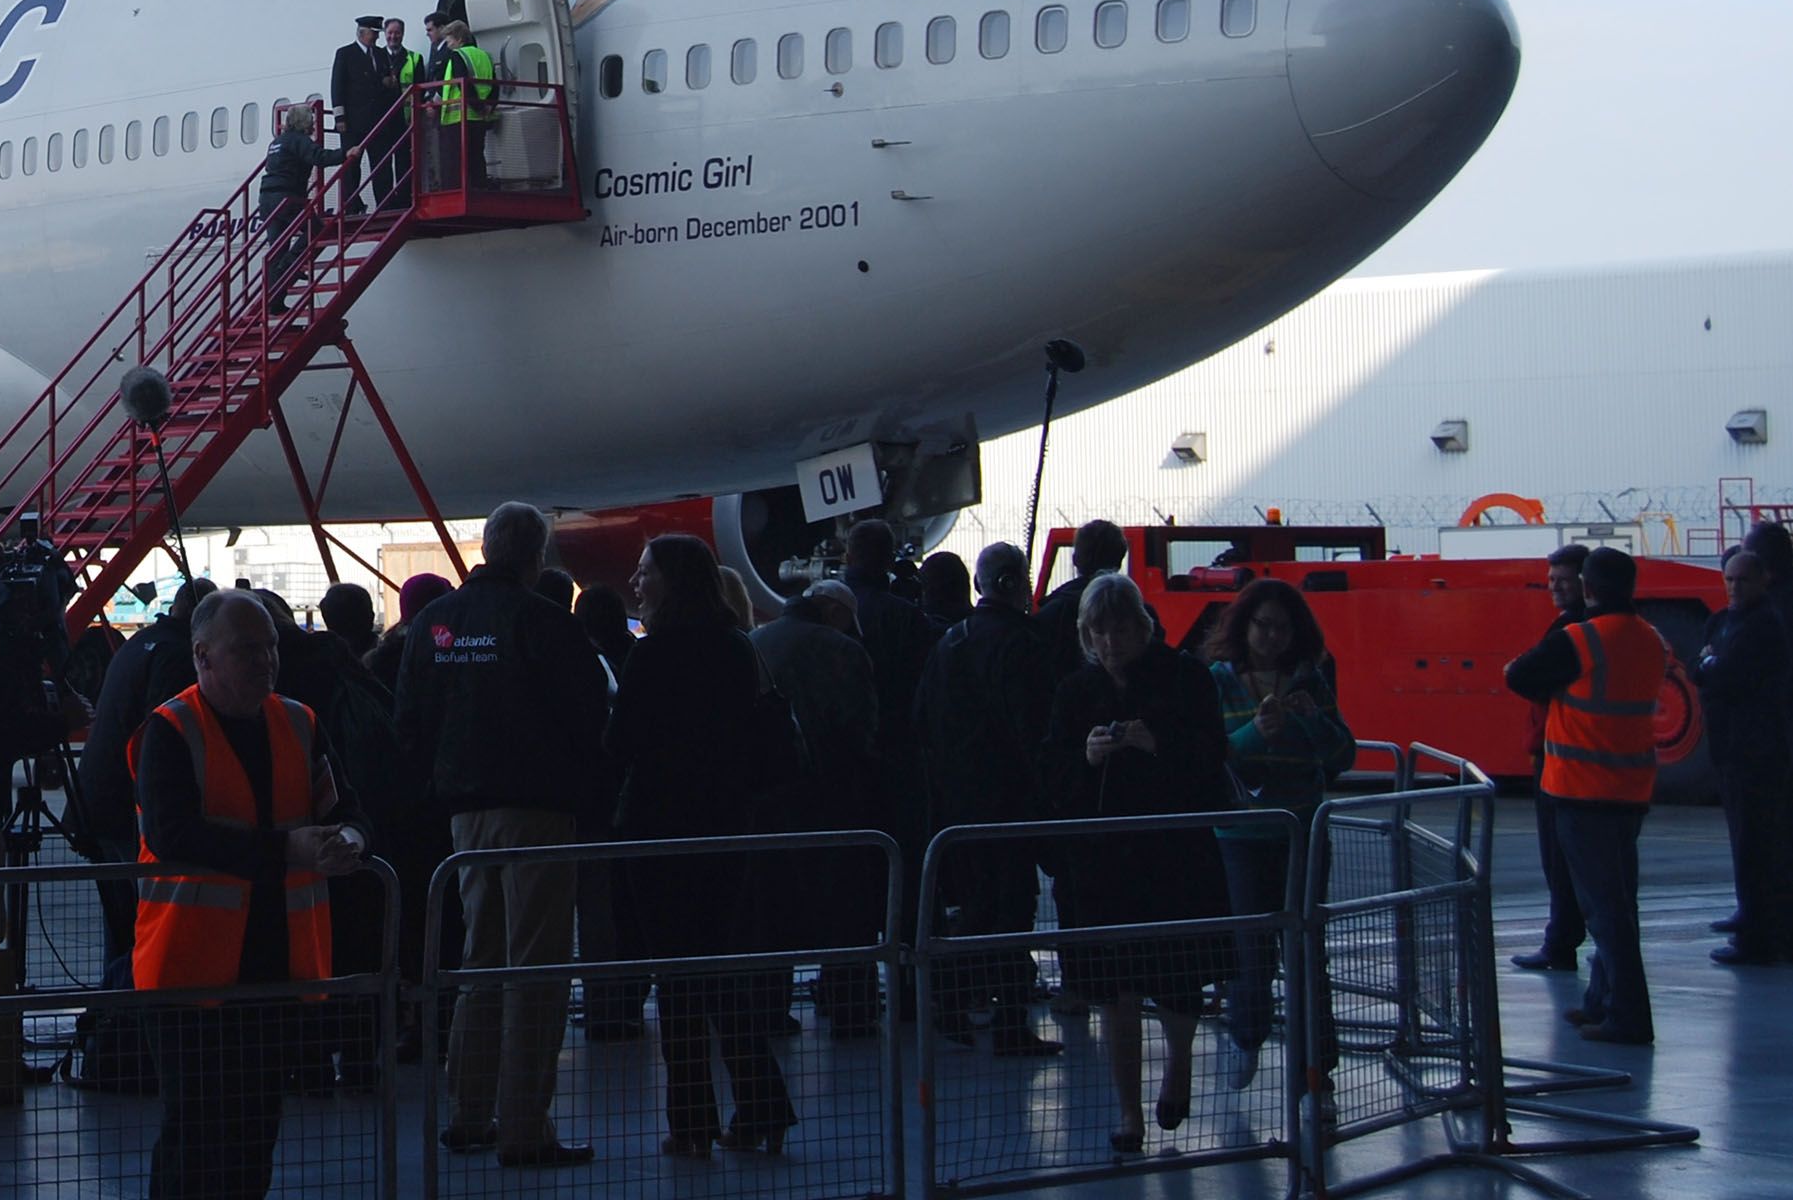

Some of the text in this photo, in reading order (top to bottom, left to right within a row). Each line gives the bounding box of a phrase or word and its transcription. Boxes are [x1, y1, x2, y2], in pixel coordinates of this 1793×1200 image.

[594, 154, 753, 200] Cosmic Girl
[599, 200, 860, 249] Air-born December 2001
[818, 462, 857, 506] OW
[434, 651, 498, 663] Biofuel Team
[454, 634, 497, 648] atlantic
